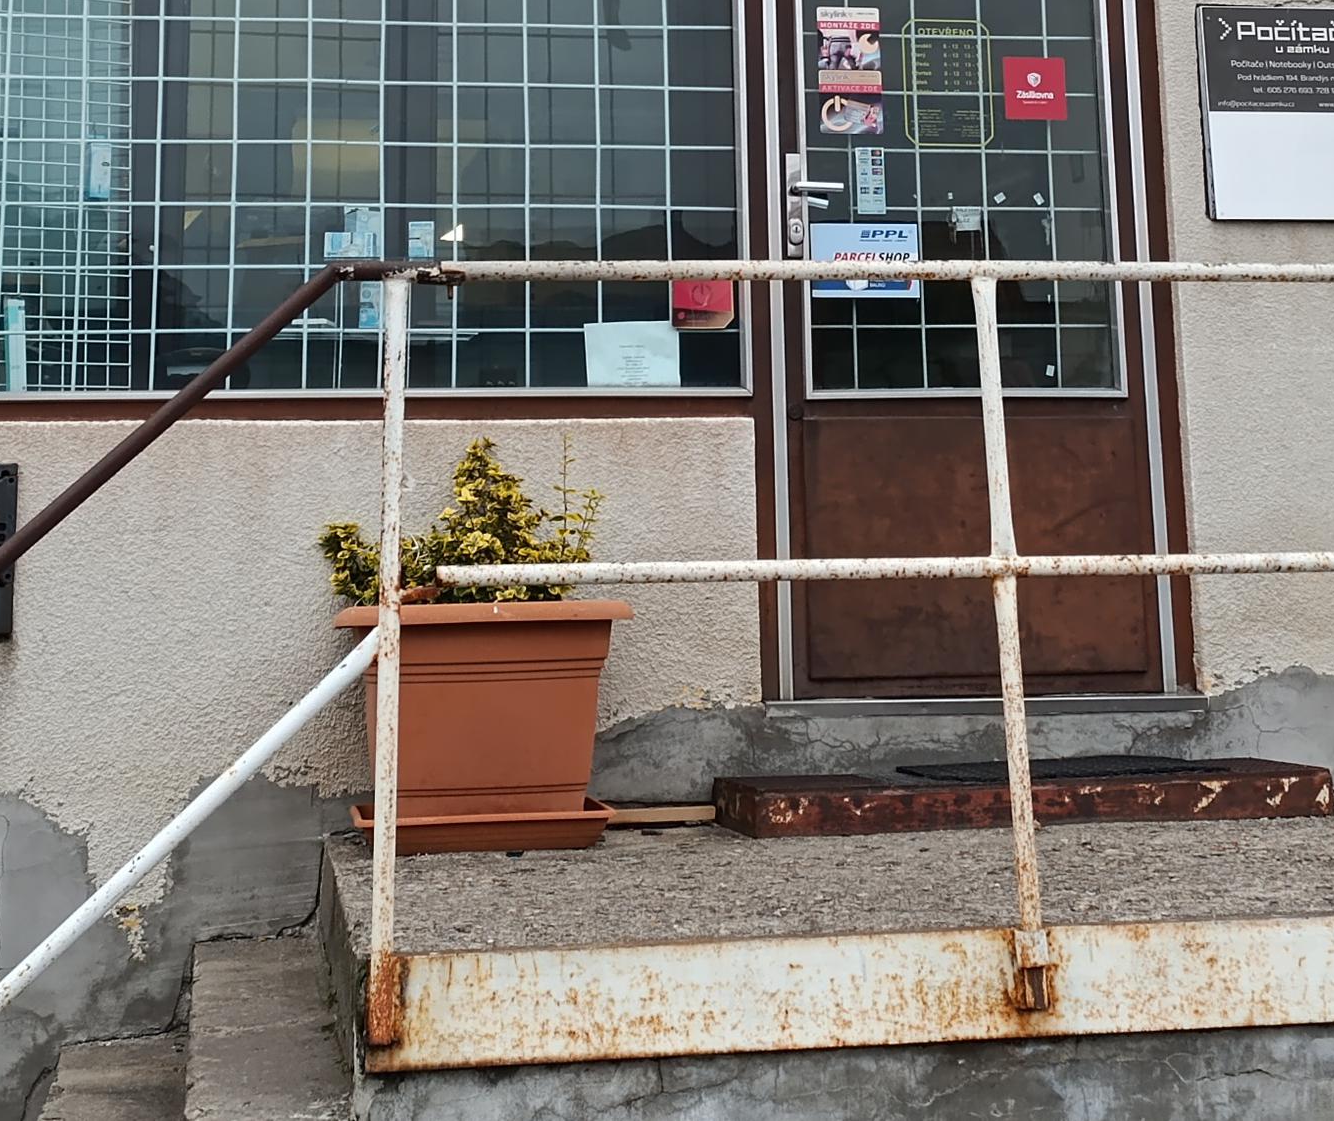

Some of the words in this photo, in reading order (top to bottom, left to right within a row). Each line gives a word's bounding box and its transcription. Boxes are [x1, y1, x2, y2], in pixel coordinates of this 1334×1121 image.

[917, 26, 974, 36] OTEVŘENO
[1275, 45, 1284, 53] u
[1287, 43, 1330, 54] zámku
[1269, 60, 1312, 69] Notebooky
[872, 230, 908, 238] PPL
